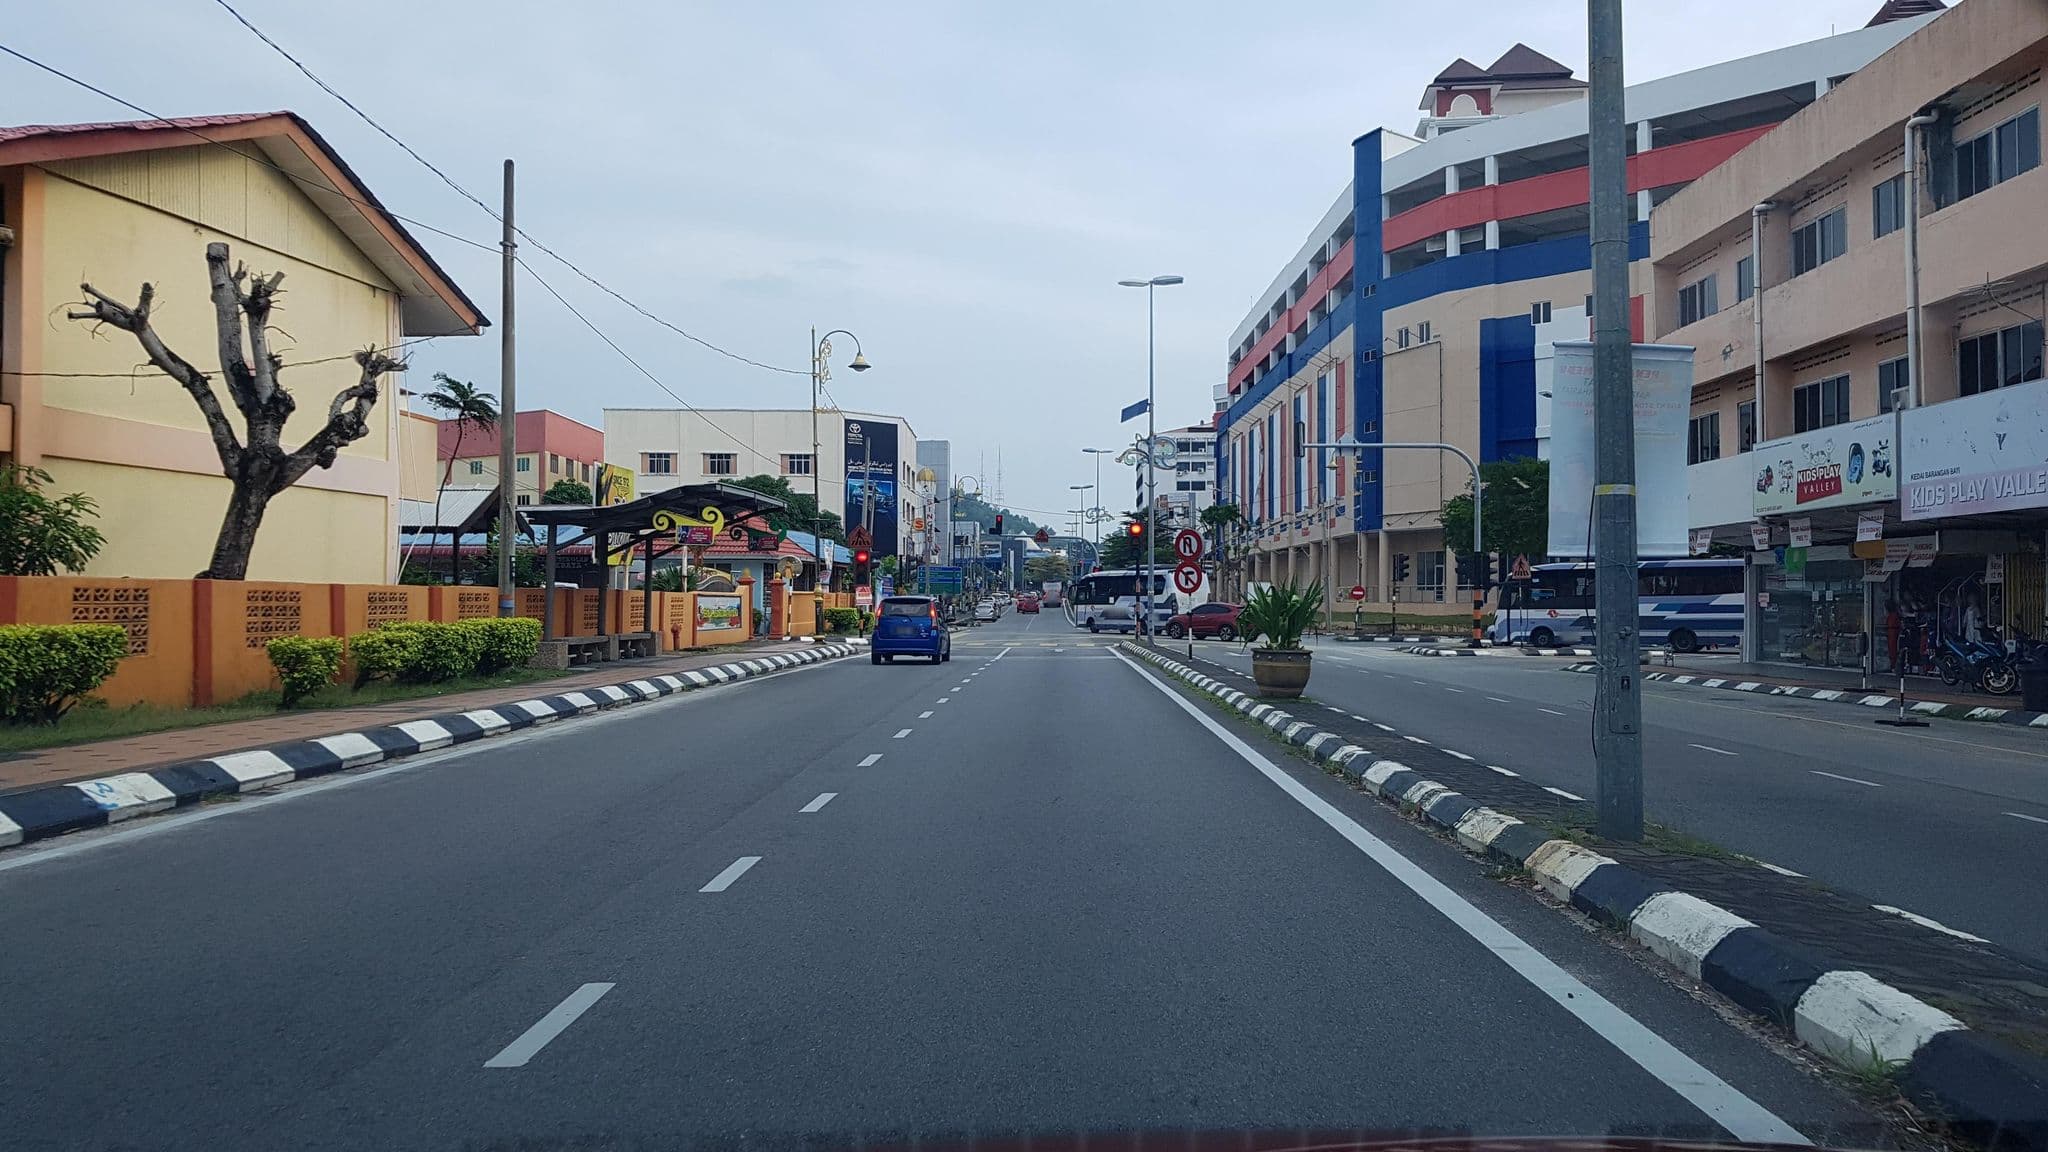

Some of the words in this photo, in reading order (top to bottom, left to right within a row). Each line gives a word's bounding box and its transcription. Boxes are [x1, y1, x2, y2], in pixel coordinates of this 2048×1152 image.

[1798, 467, 1818, 484] KIDS
[1819, 463, 1841, 480] PLAY
[1910, 471, 1925, 481] KEDAI
[1925, 468, 1950, 479] BARANGAN
[1803, 480, 1835, 494] VALLEY
[1911, 485, 1945, 508] KIDS
[1949, 478, 1988, 504] PLAY
